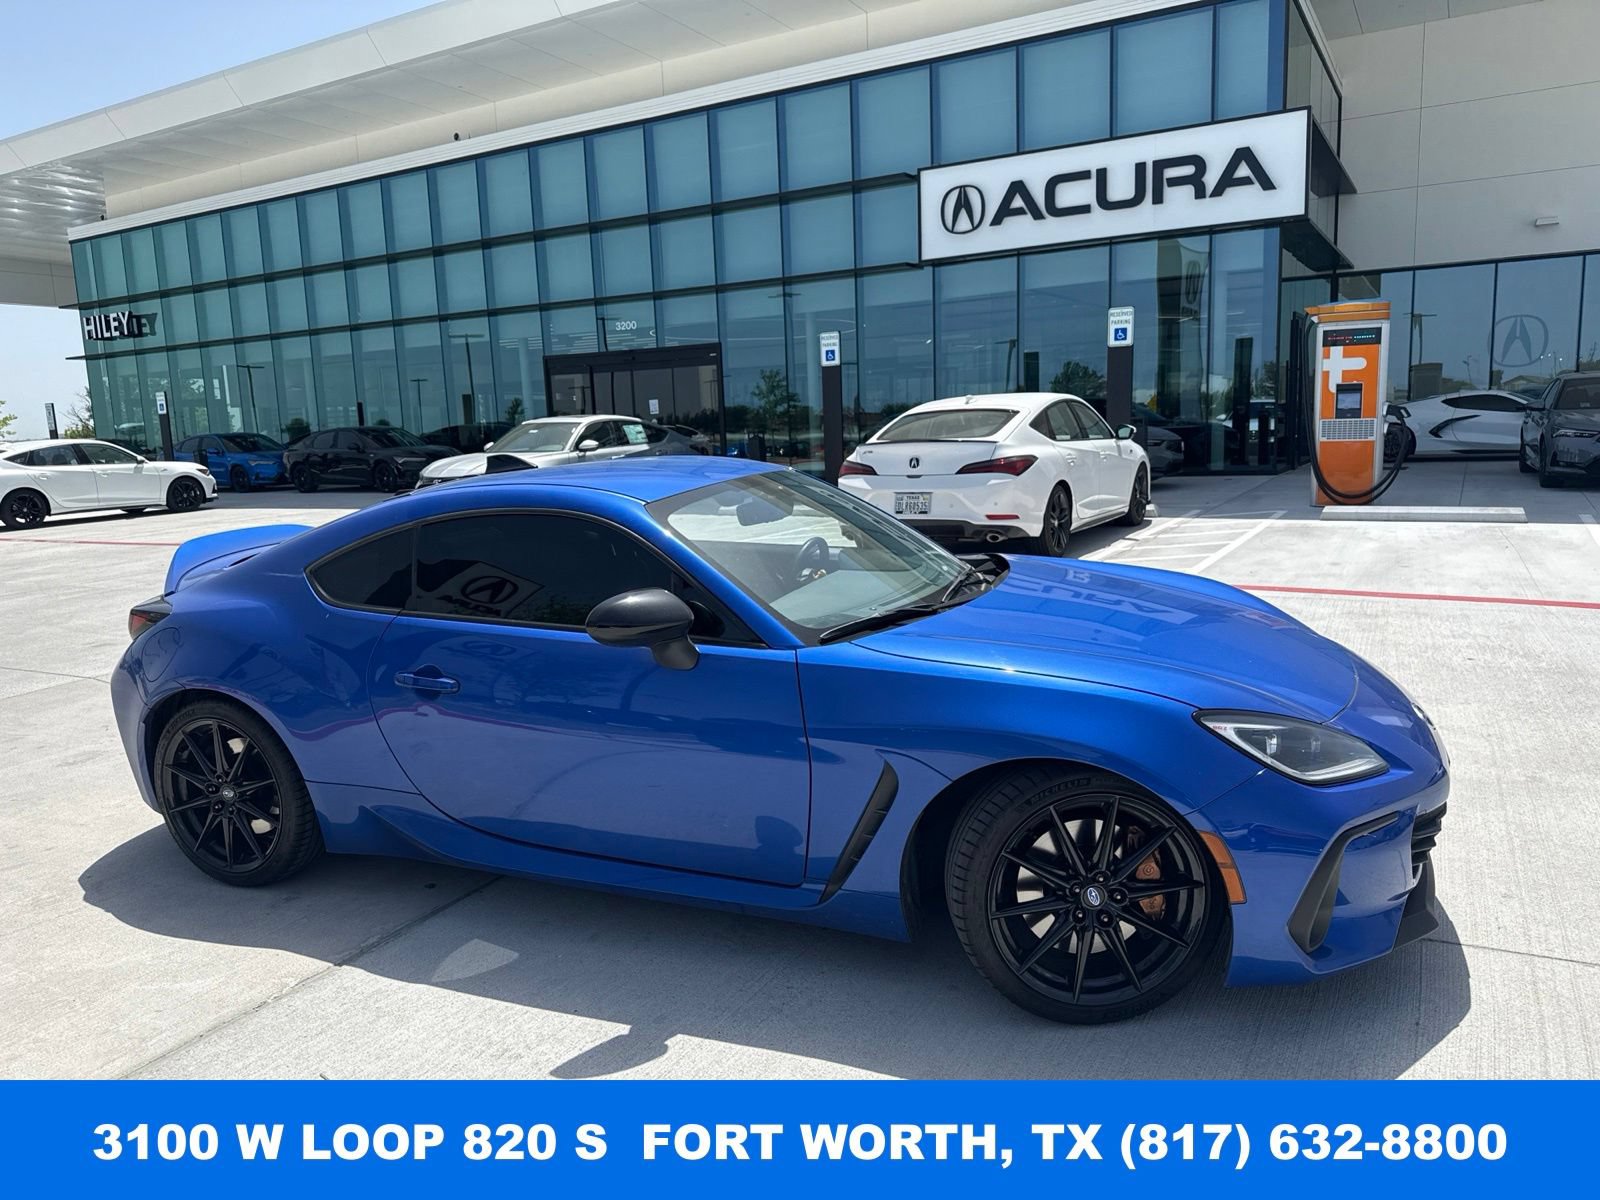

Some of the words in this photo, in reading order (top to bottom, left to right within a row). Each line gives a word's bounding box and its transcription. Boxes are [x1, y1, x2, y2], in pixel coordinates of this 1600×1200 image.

[989, 146, 1277, 226] ACURA
[83, 311, 129, 340] HILEY
[615, 321, 637, 331] 3200
